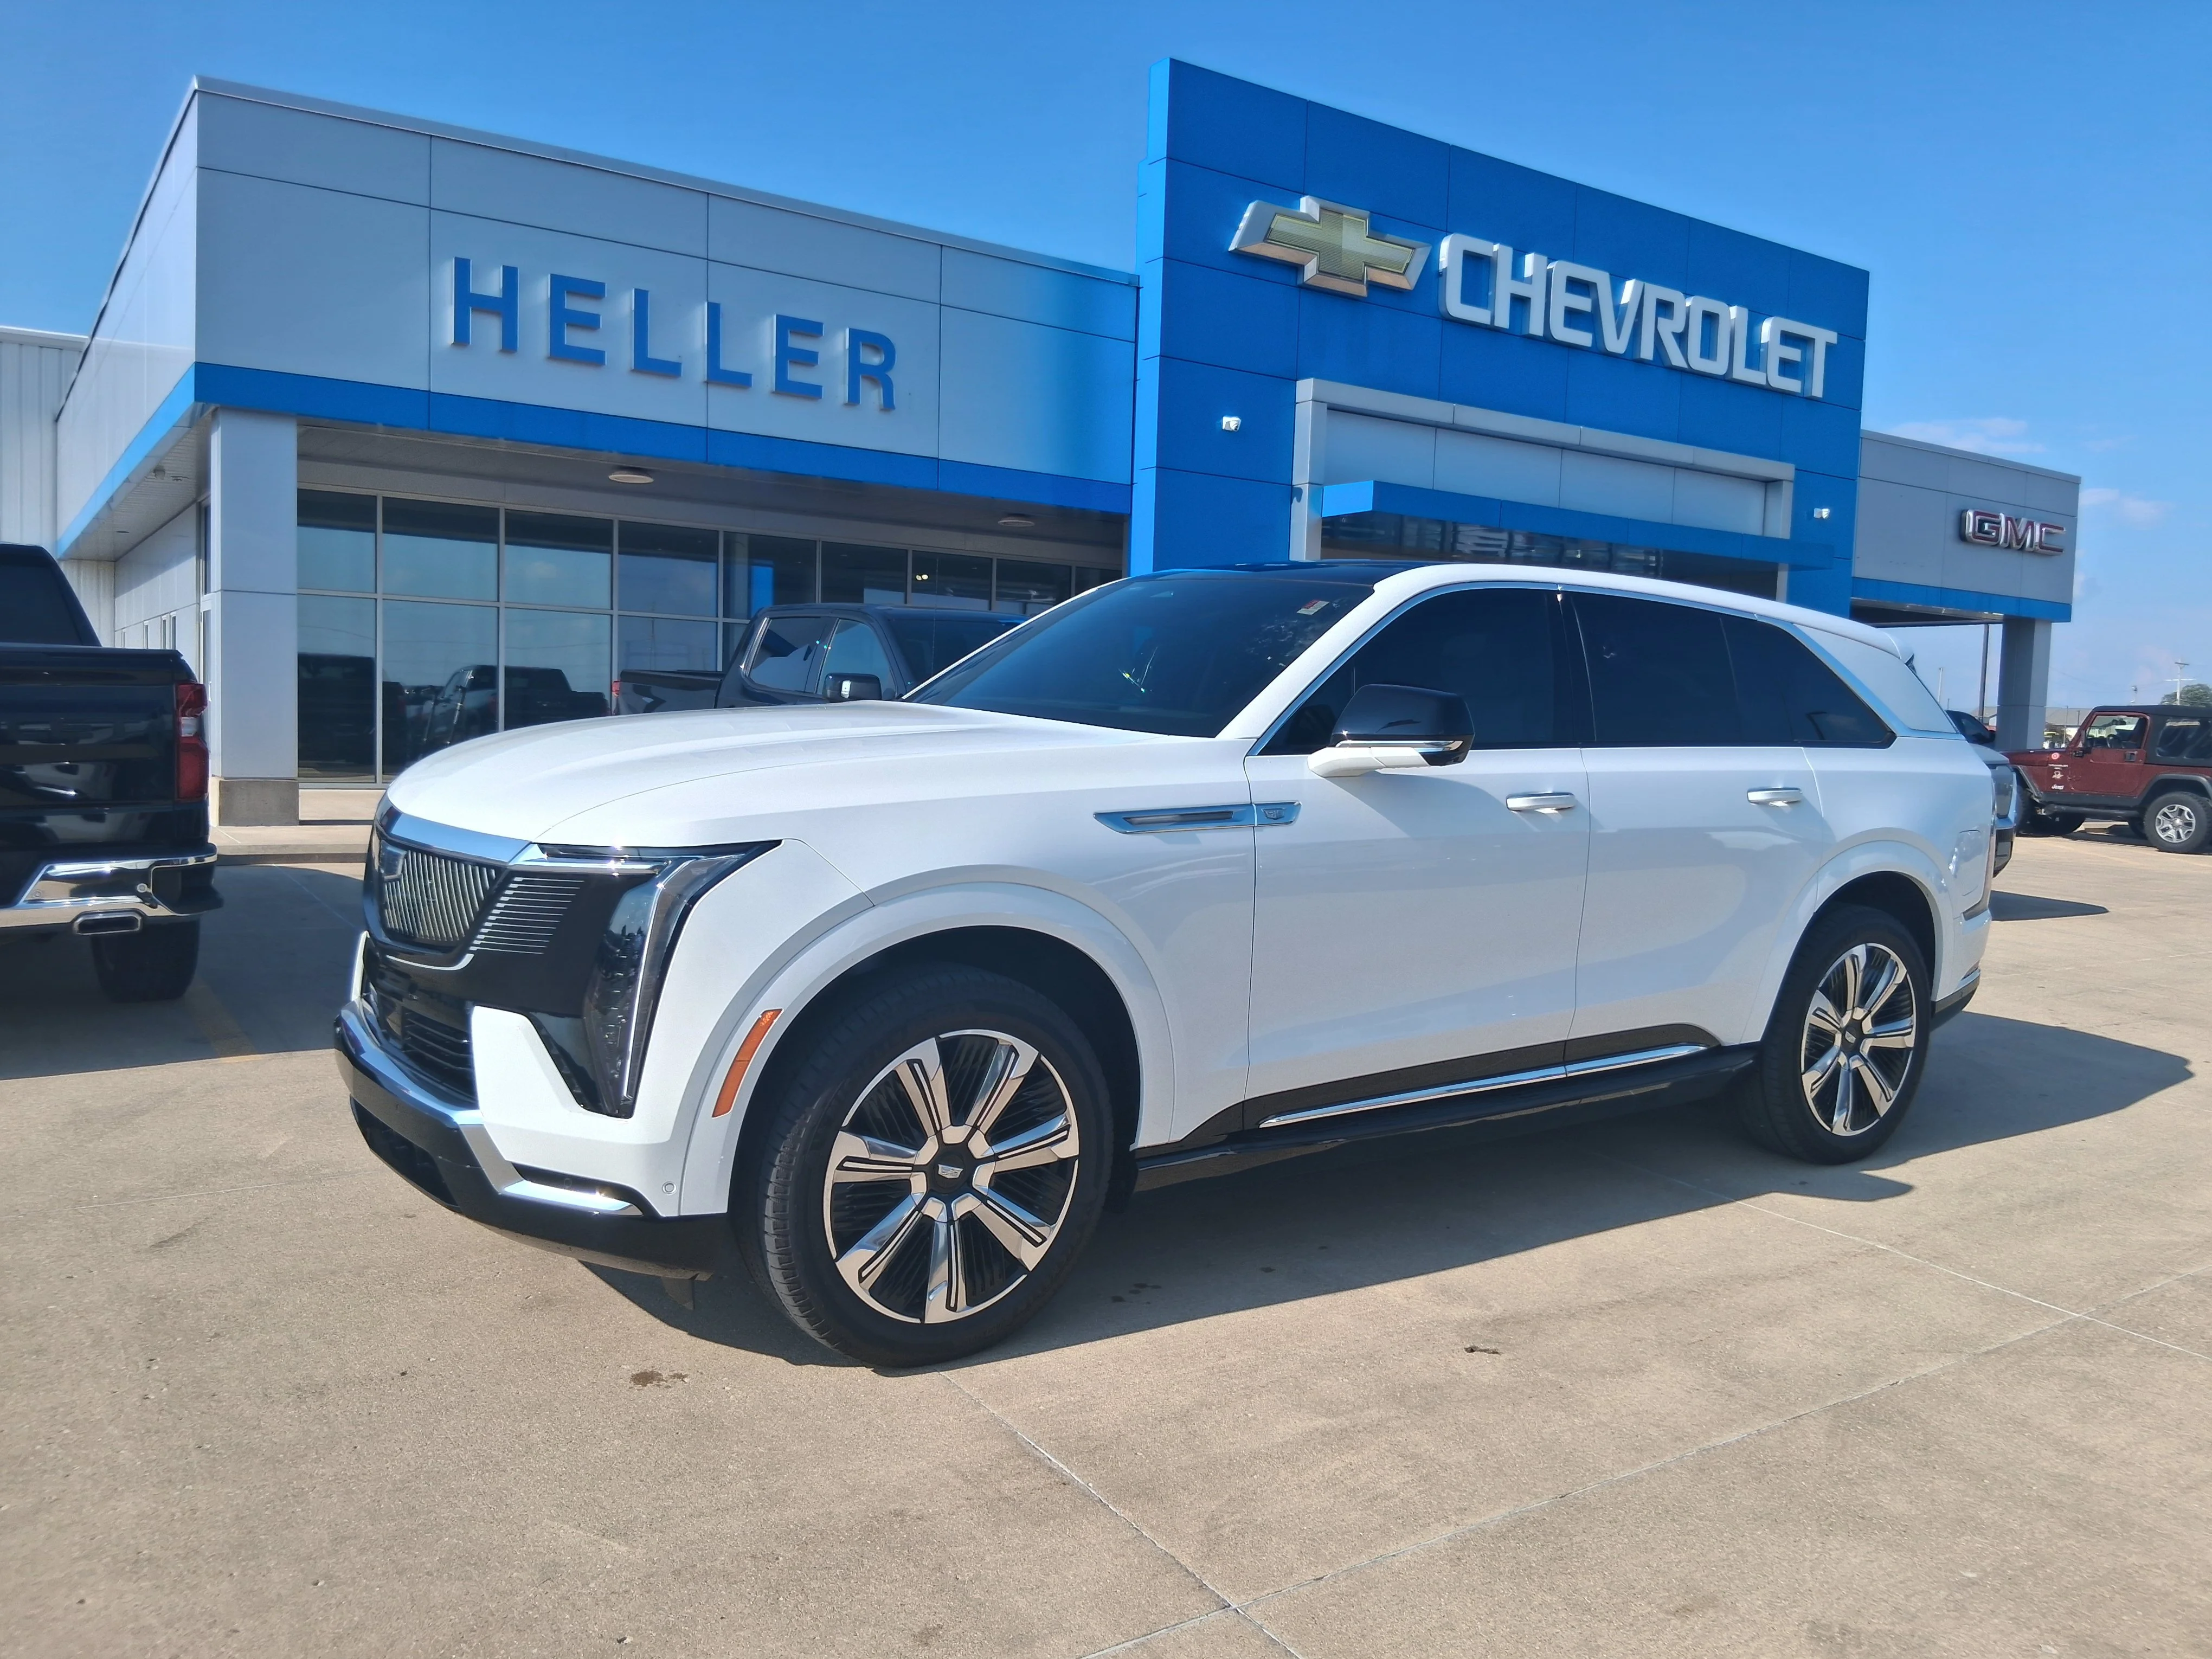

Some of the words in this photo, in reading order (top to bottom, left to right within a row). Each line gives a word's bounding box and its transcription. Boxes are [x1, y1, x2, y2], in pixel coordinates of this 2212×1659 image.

[453, 256, 896, 411] HELLER
[1439, 233, 1837, 398] CHEVROLET
[1960, 509, 2066, 555] GMC
